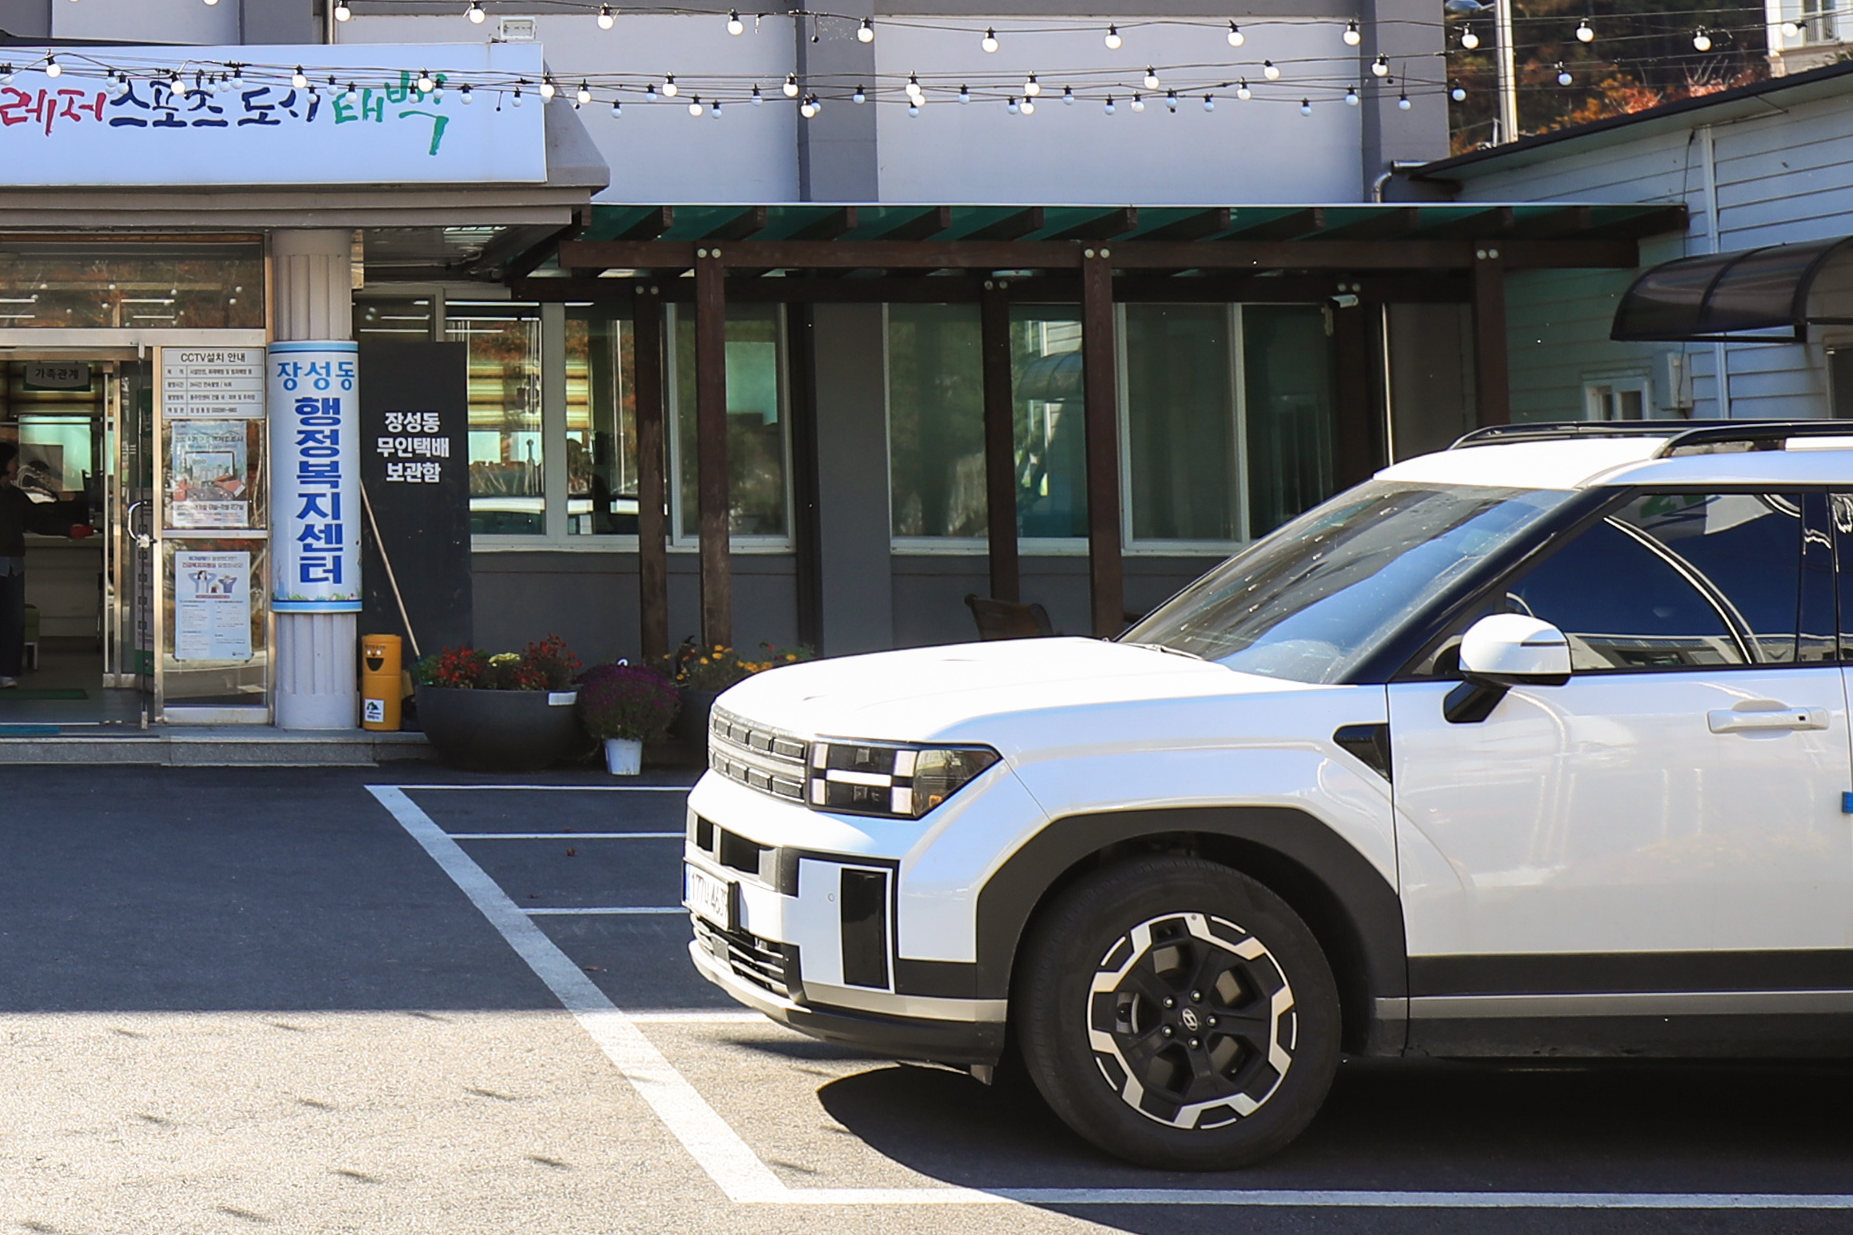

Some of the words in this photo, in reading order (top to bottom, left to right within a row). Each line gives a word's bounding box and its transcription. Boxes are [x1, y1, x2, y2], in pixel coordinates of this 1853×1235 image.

[180, 352, 224, 363] CCTV설치
[227, 352, 246, 363] 안내
[35, 368, 79, 380] 가족관계
[277, 361, 356, 391] 장성동
[384, 412, 441, 433] 장성동
[376, 436, 450, 458] 무인택배
[385, 462, 442, 483] 보관함
[294, 396, 344, 585] 행정복지센터
